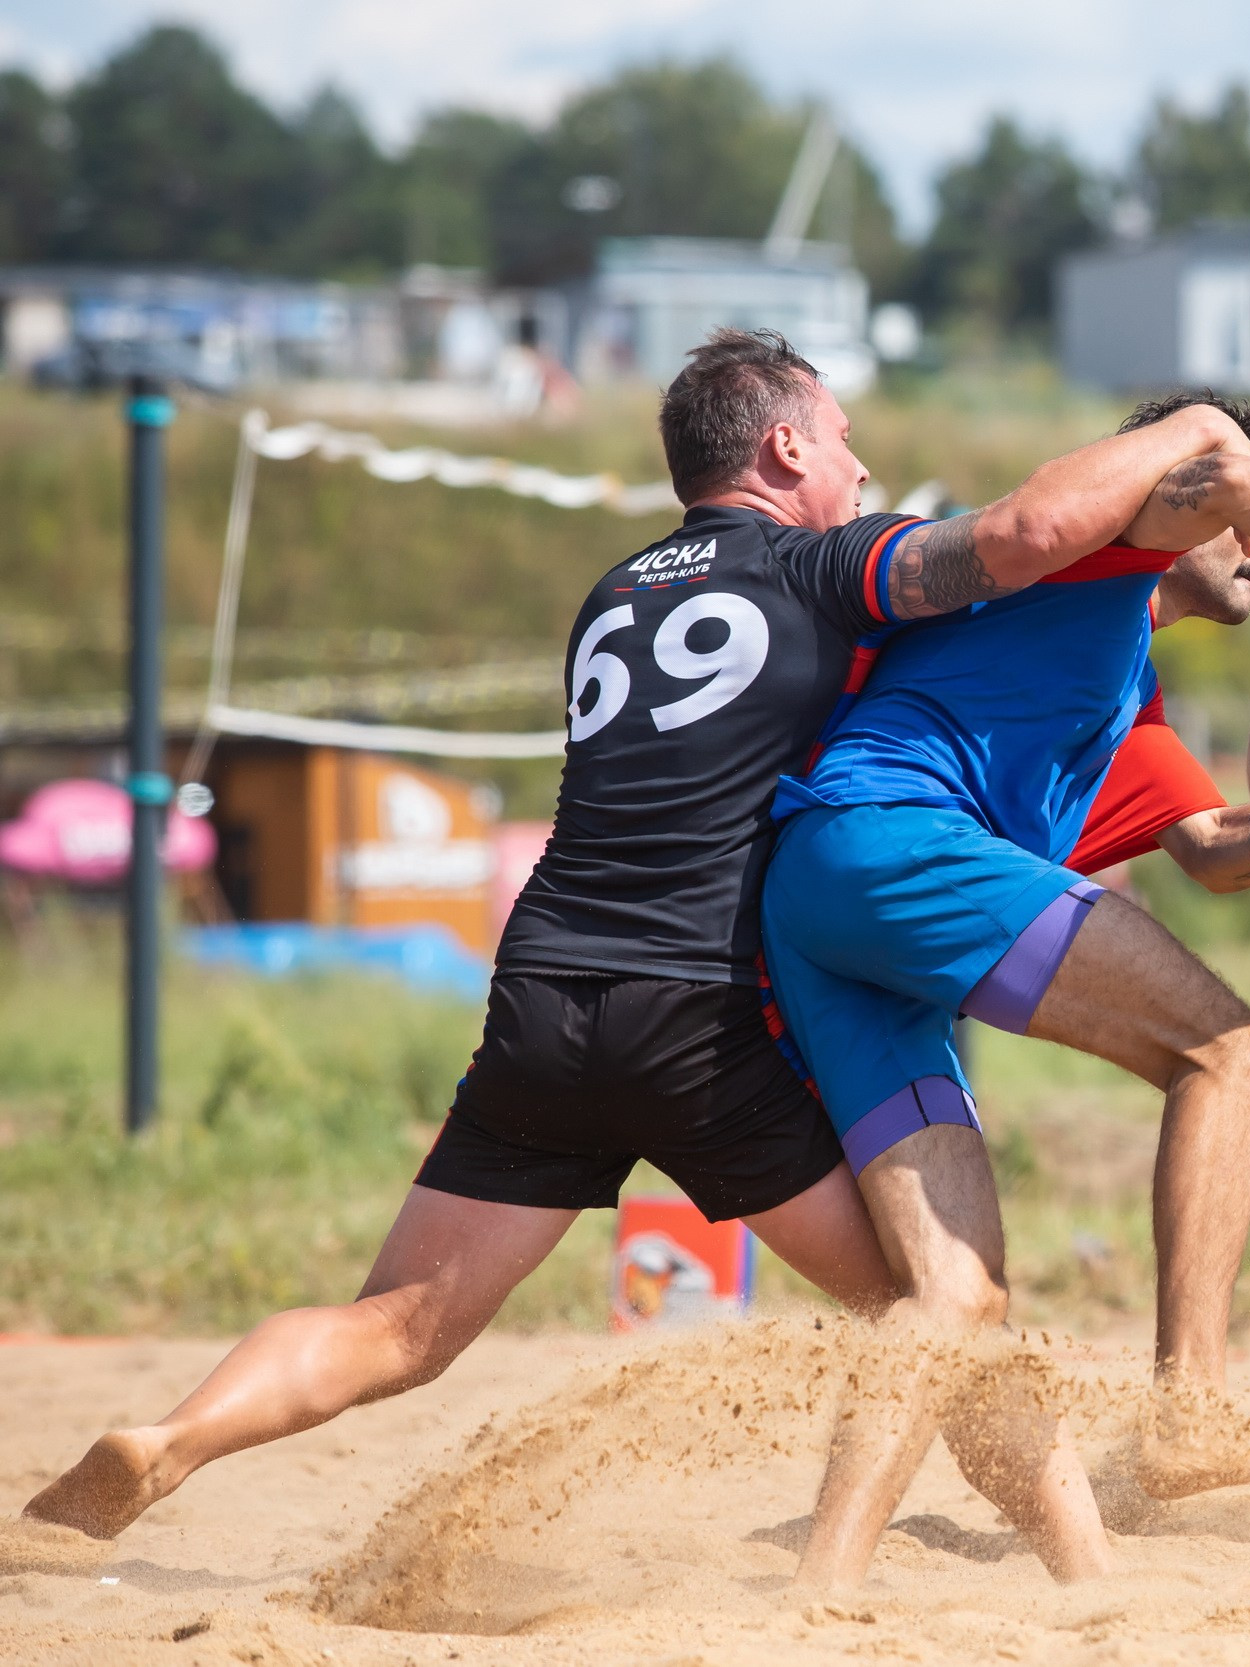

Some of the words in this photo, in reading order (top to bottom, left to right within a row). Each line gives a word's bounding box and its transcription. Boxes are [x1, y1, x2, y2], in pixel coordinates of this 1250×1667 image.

[627, 537, 717, 573] ЦСКА
[637, 562, 710, 584] РЕГБИ-КЛУБ
[568, 592, 769, 742] 69
